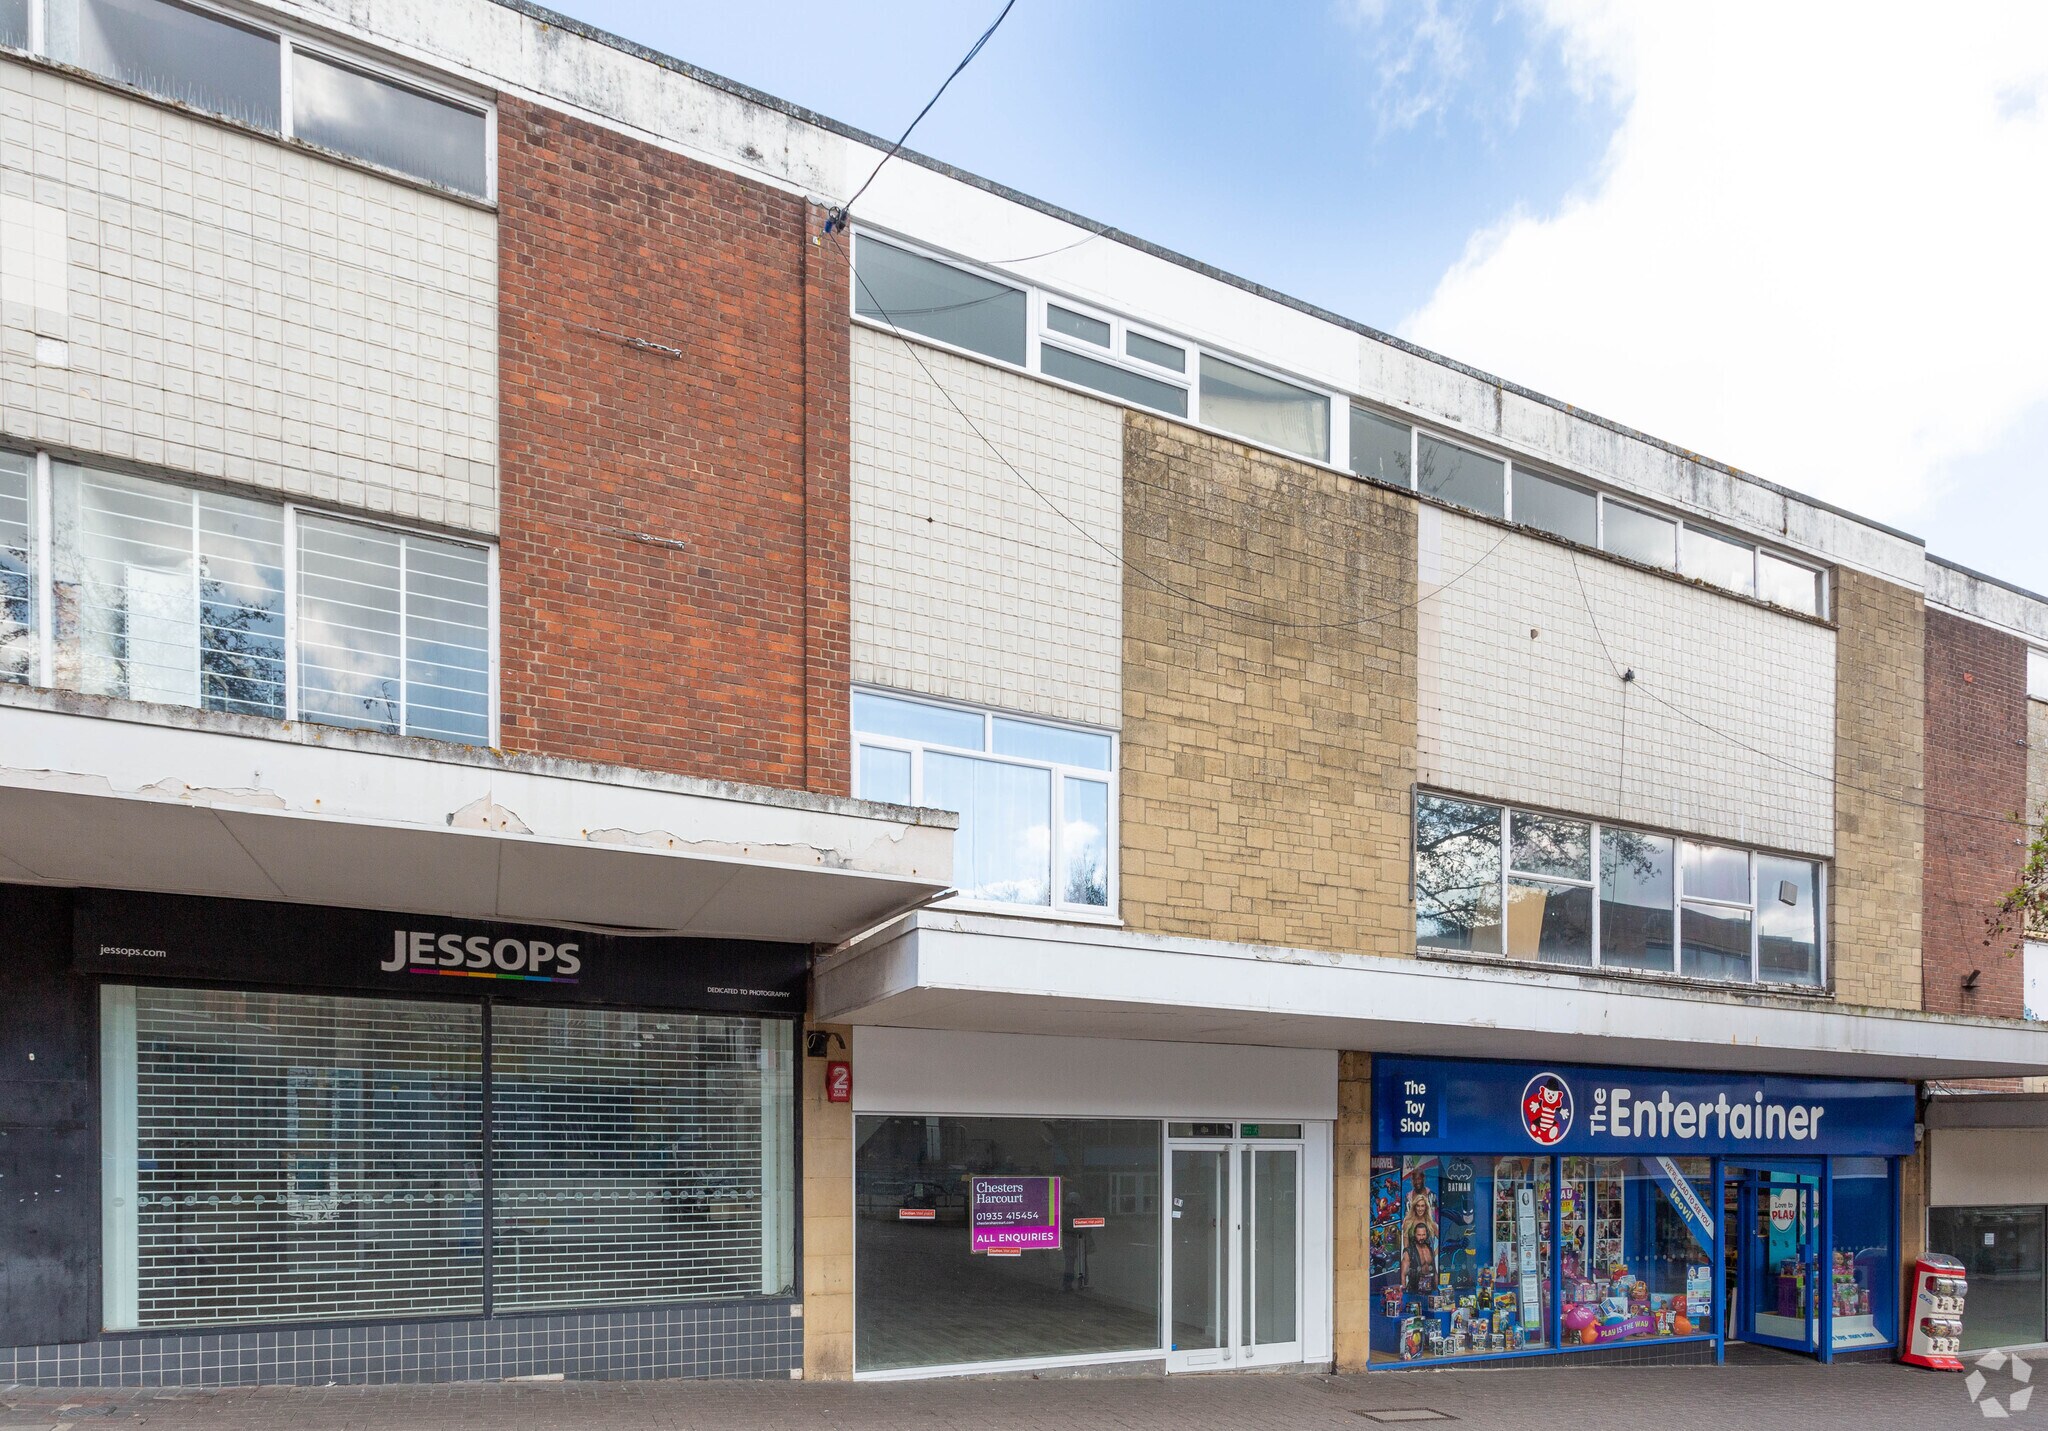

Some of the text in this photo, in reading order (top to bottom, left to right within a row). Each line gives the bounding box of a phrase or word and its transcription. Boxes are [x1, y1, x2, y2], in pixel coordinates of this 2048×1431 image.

[99, 944, 166, 958] jessops.com
[381, 930, 581, 975] JESSOPS
[707, 986, 791, 998] DEDICATED TO PHOTOGRAPHY
[833, 1066, 848, 1089] 2
[1404, 1080, 1426, 1095] The
[1405, 1100, 1425, 1118] Toy
[1589, 1088, 1825, 1140] The Entertainer
[1400, 1118, 1431, 1136] Shop
[1371, 1157, 1394, 1169] MARVEL
[976, 1181, 1024, 1193] Chesters
[1448, 1182, 1471, 1192] BATMAN
[976, 1193, 1023, 1204] Harcourt
[1676, 1179, 1689, 1196] GLAD
[1687, 1194, 1695, 1205] TO
[1693, 1203, 1702, 1215] SEE
[1700, 1213, 1711, 1228] YOU
[1774, 1201, 1787, 1209] Love
[976, 1211, 1039, 1221] 01935 415454
[1772, 1209, 1795, 1221] PLAY
[976, 1232, 1054, 1243] ALL ENQUIRIES
[1601, 1320, 1649, 1338] PLAY IS THE WAY
